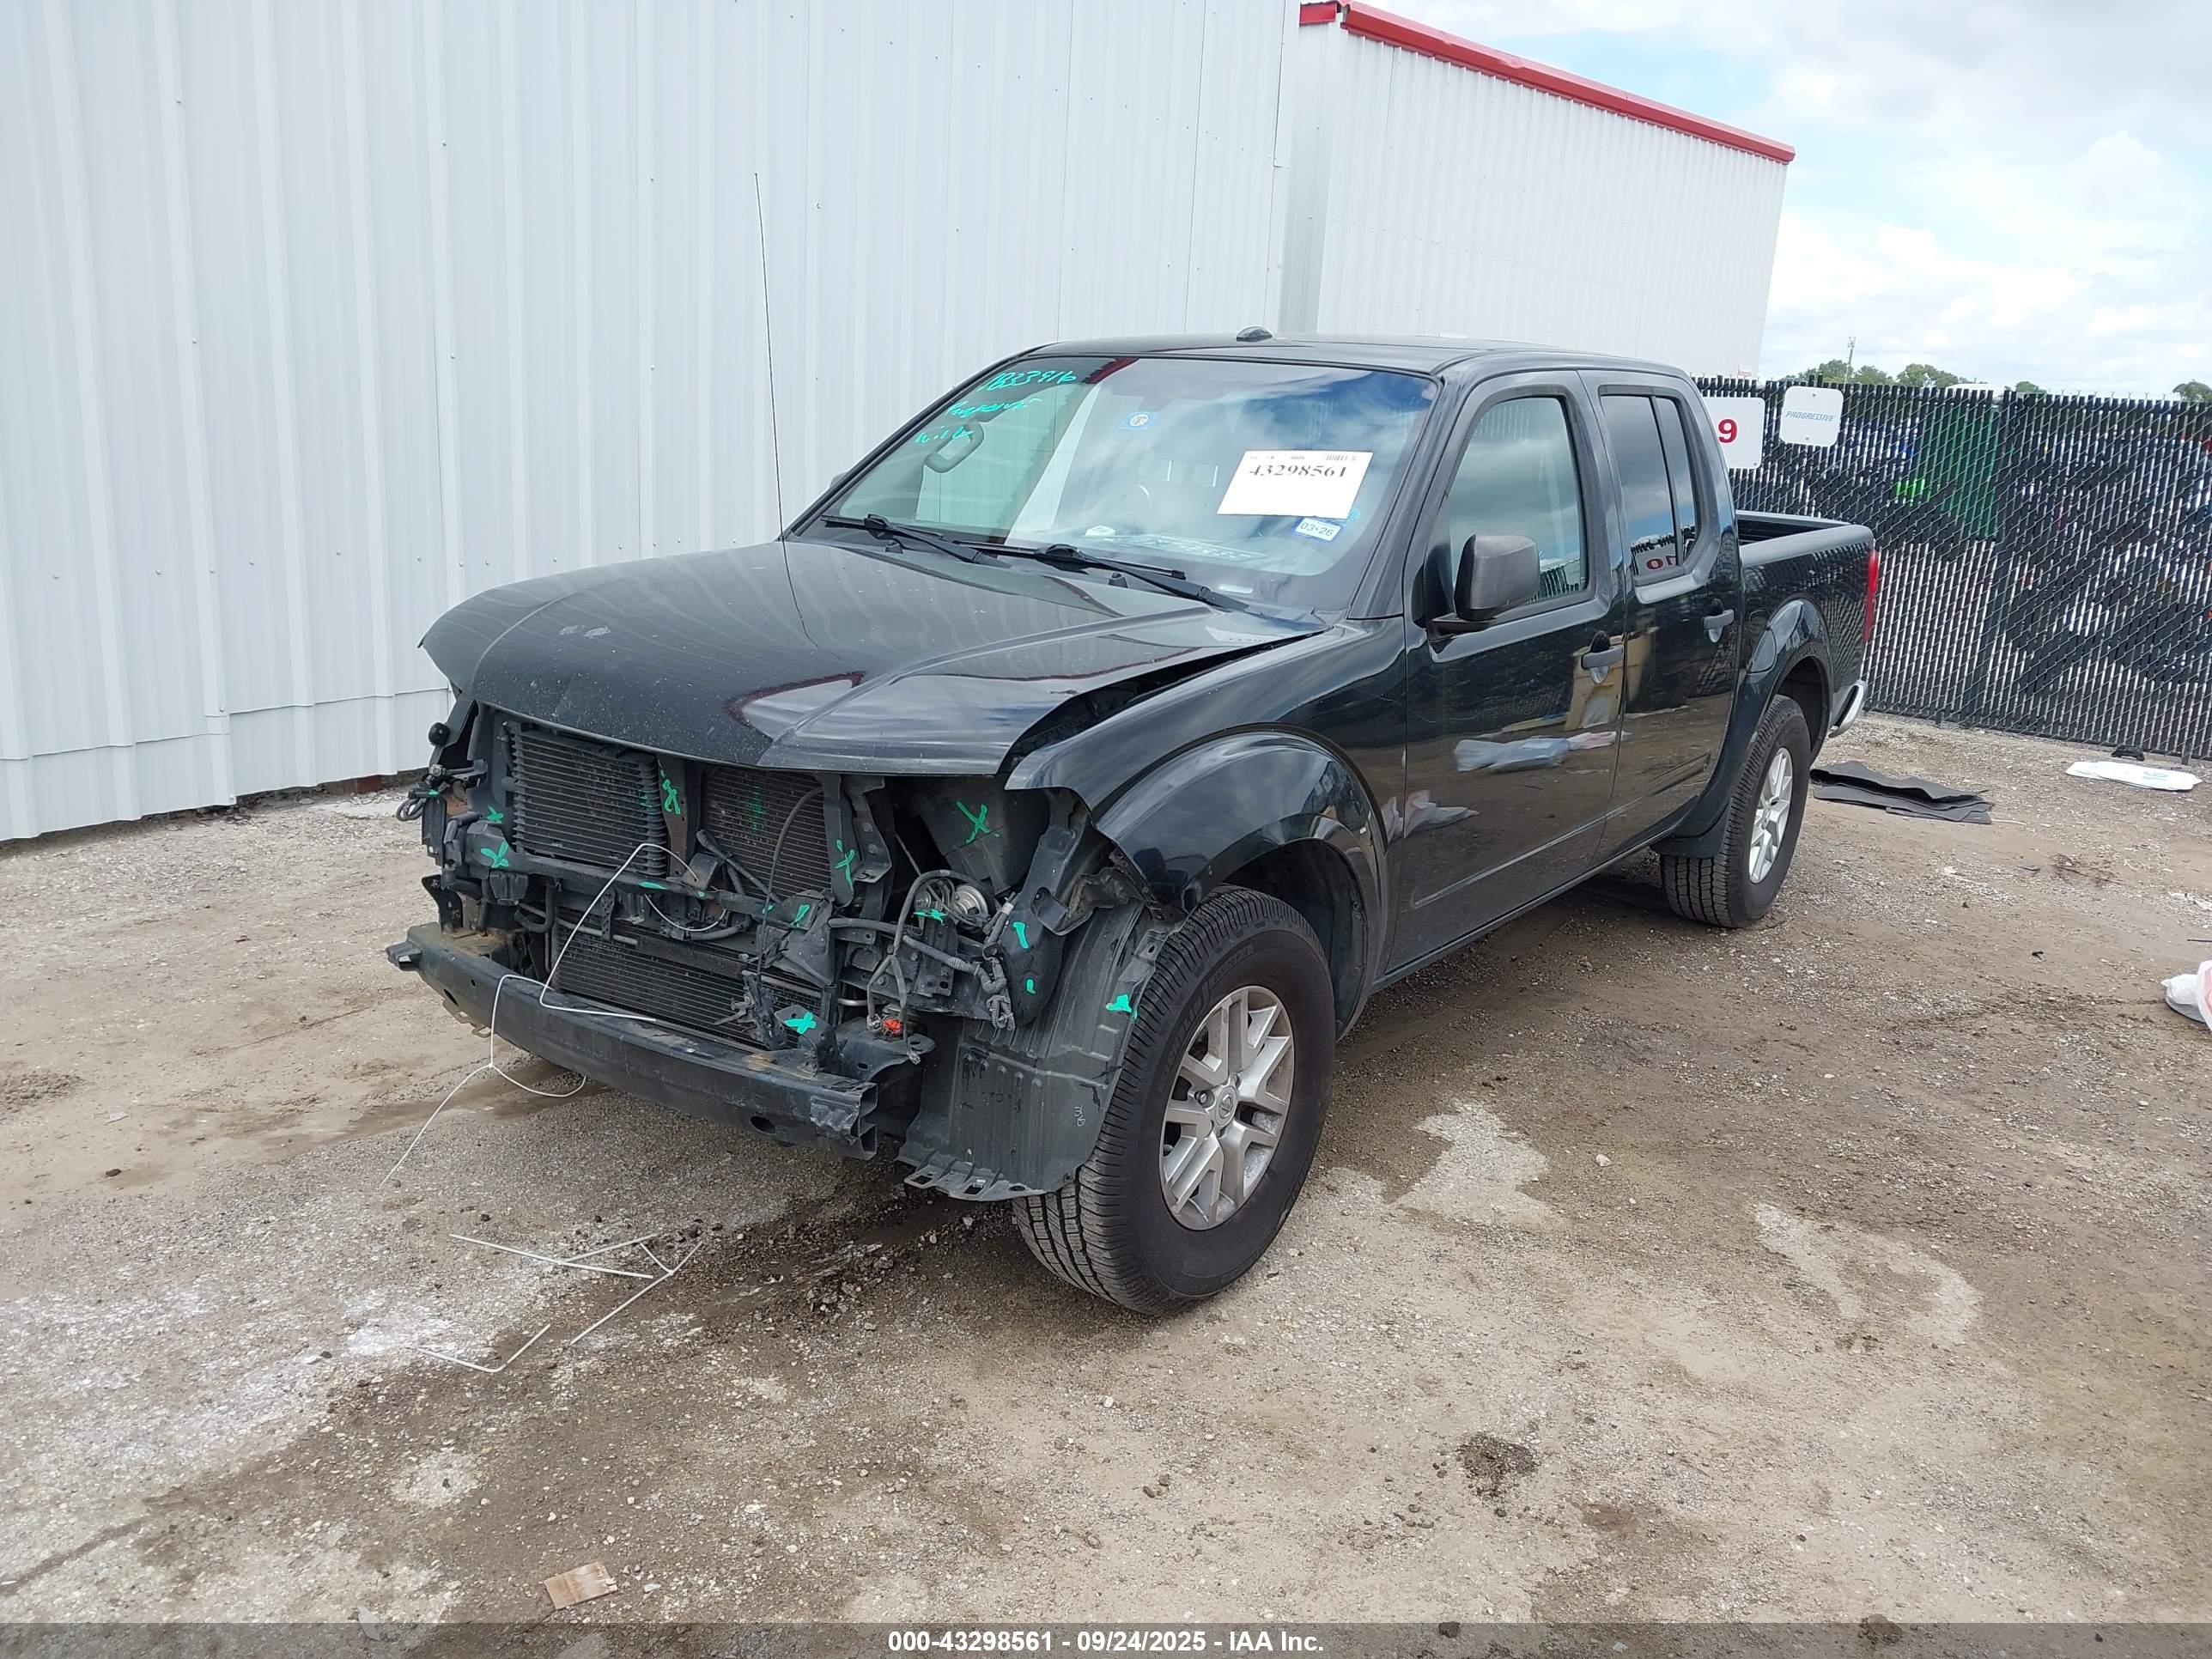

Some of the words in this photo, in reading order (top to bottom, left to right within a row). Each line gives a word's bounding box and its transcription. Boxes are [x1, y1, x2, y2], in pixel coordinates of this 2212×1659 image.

[1785, 410, 1835, 422] PROGRESSIVE
[1717, 418, 1738, 443] 9
[1249, 465, 1346, 477] 43298561
